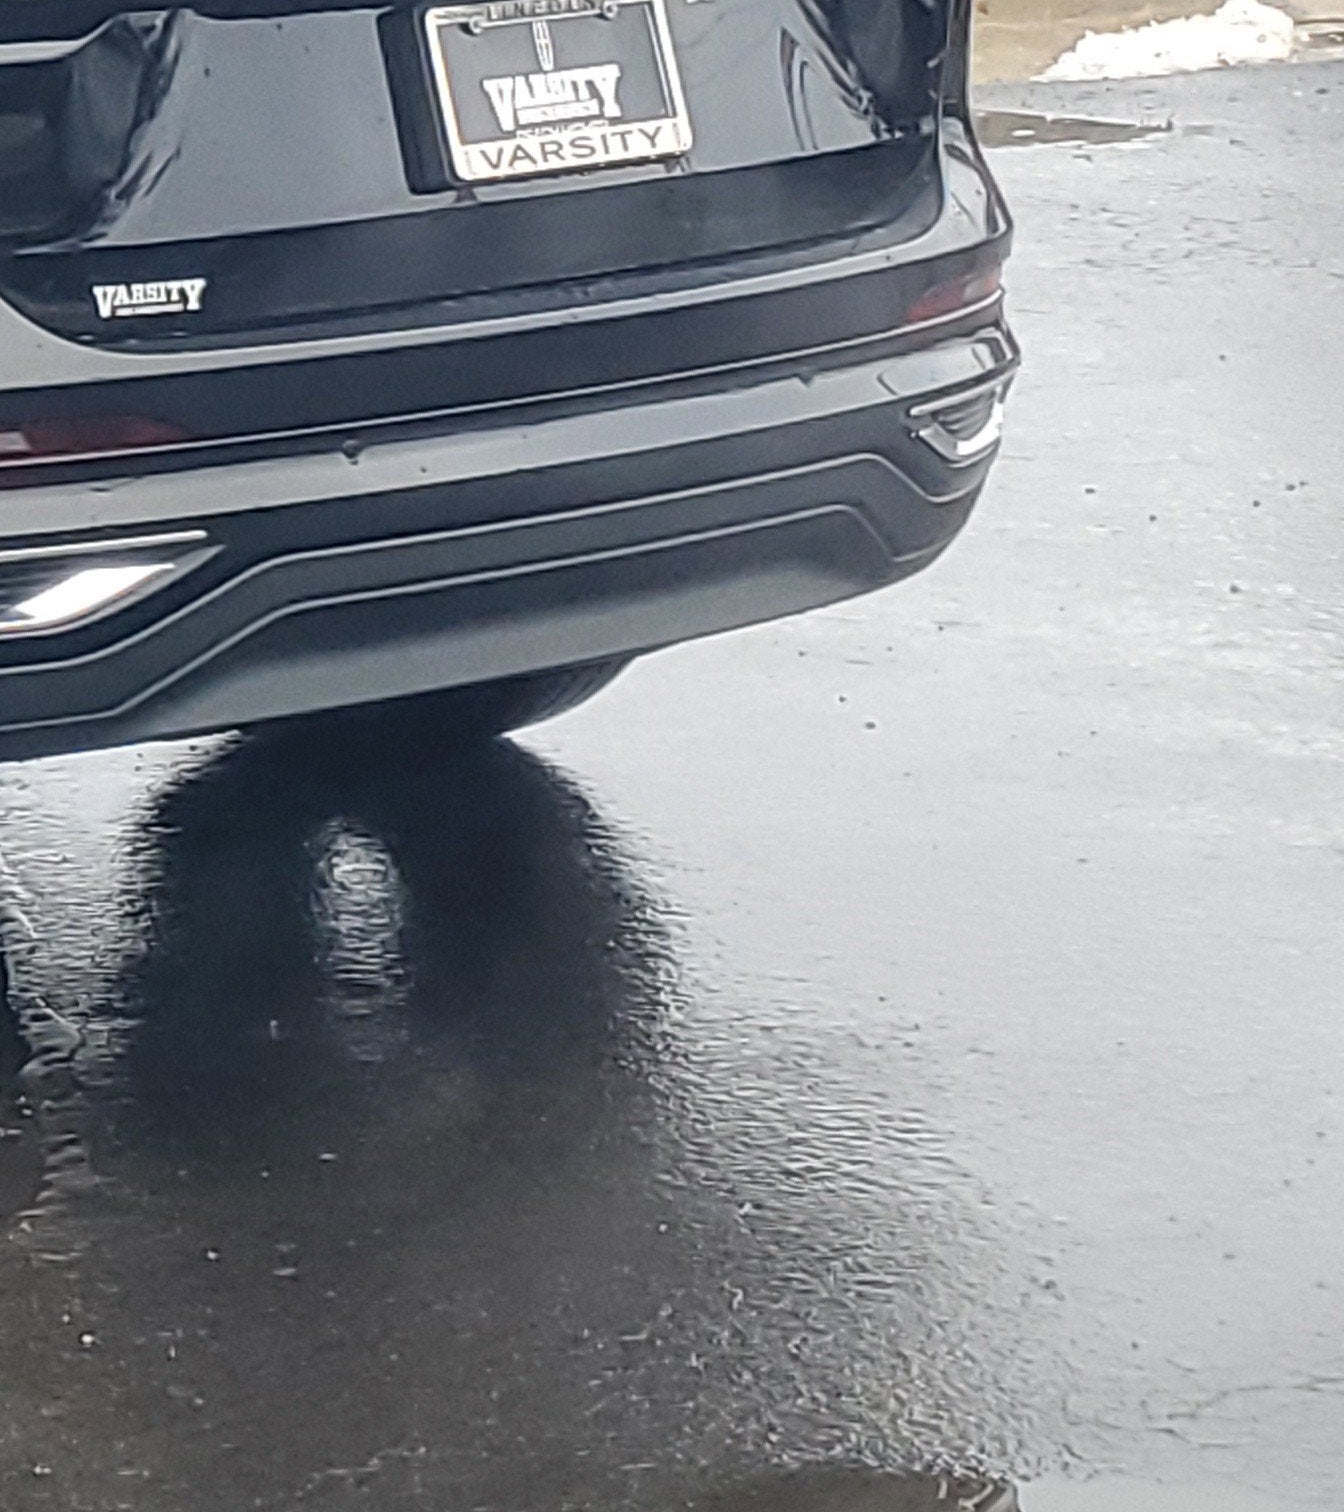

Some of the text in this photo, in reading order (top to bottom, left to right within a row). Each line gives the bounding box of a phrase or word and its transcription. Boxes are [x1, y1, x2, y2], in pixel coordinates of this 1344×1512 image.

[481, 63, 622, 135] VARSITY
[480, 126, 663, 170] VARSITY
[92, 277, 207, 319] VARSITY
